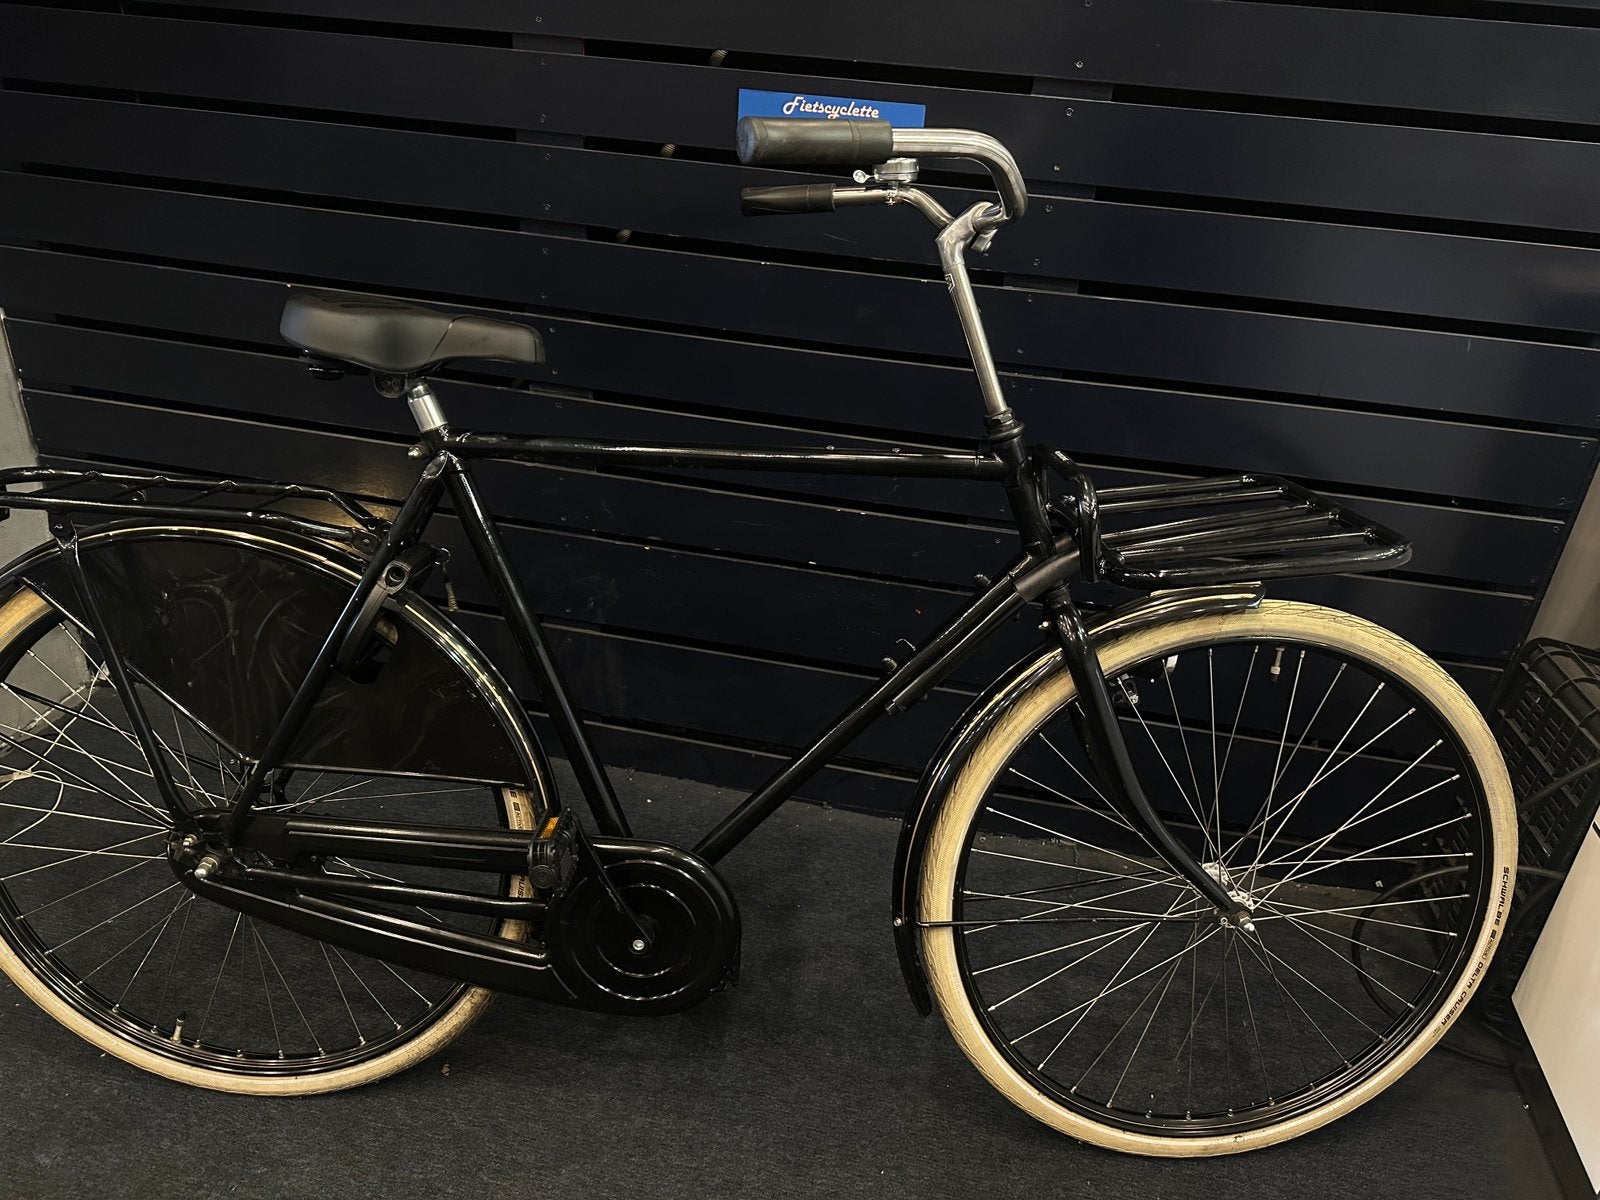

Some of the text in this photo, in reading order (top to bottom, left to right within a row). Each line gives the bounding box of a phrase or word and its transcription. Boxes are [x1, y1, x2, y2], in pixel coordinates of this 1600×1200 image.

[782, 96, 880, 119] Fietscyclette
[1494, 866, 1510, 927] SCHWALBE
[1466, 961, 1484, 989] DELTA
[1440, 990, 1467, 1027] CRUISER
